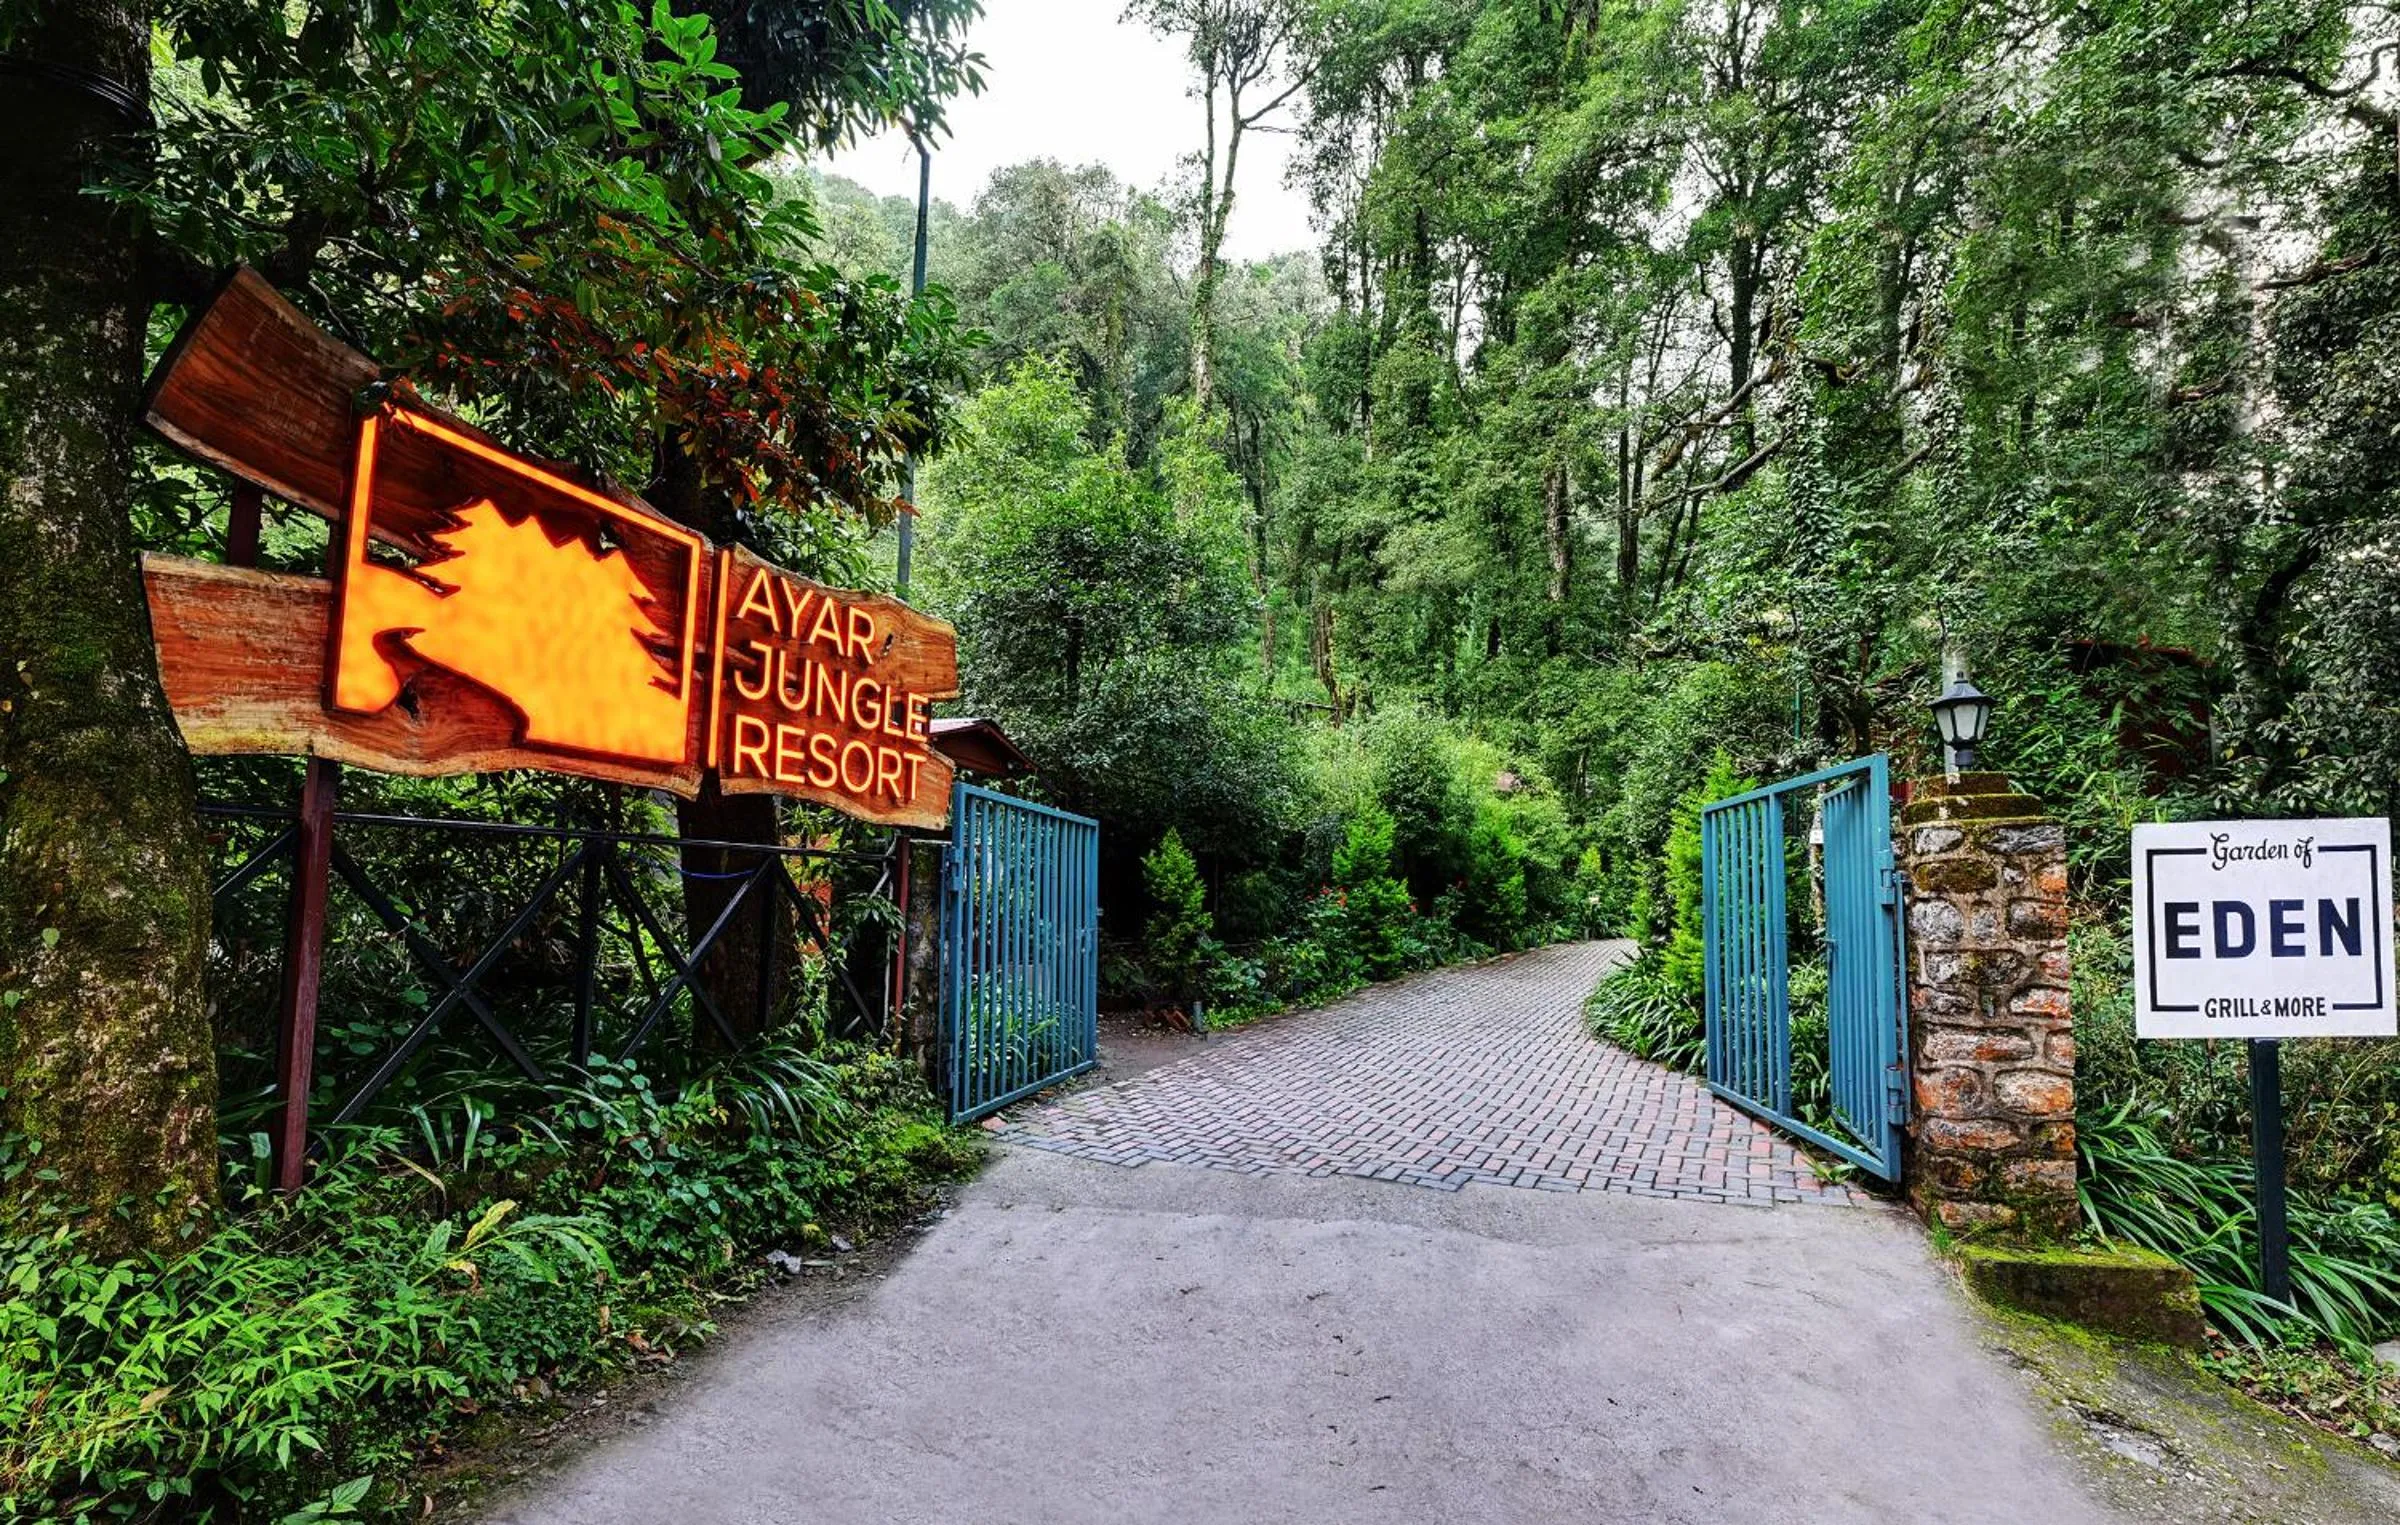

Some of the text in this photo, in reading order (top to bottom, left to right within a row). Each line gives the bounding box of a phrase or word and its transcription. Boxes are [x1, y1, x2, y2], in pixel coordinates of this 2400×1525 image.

[737, 568, 875, 664] AYAR
[735, 641, 928, 742] JUNGLE
[734, 714, 927, 800] RESORT
[2210, 833, 2314, 870] Garden of
[2164, 897, 2363, 959] EDEN
